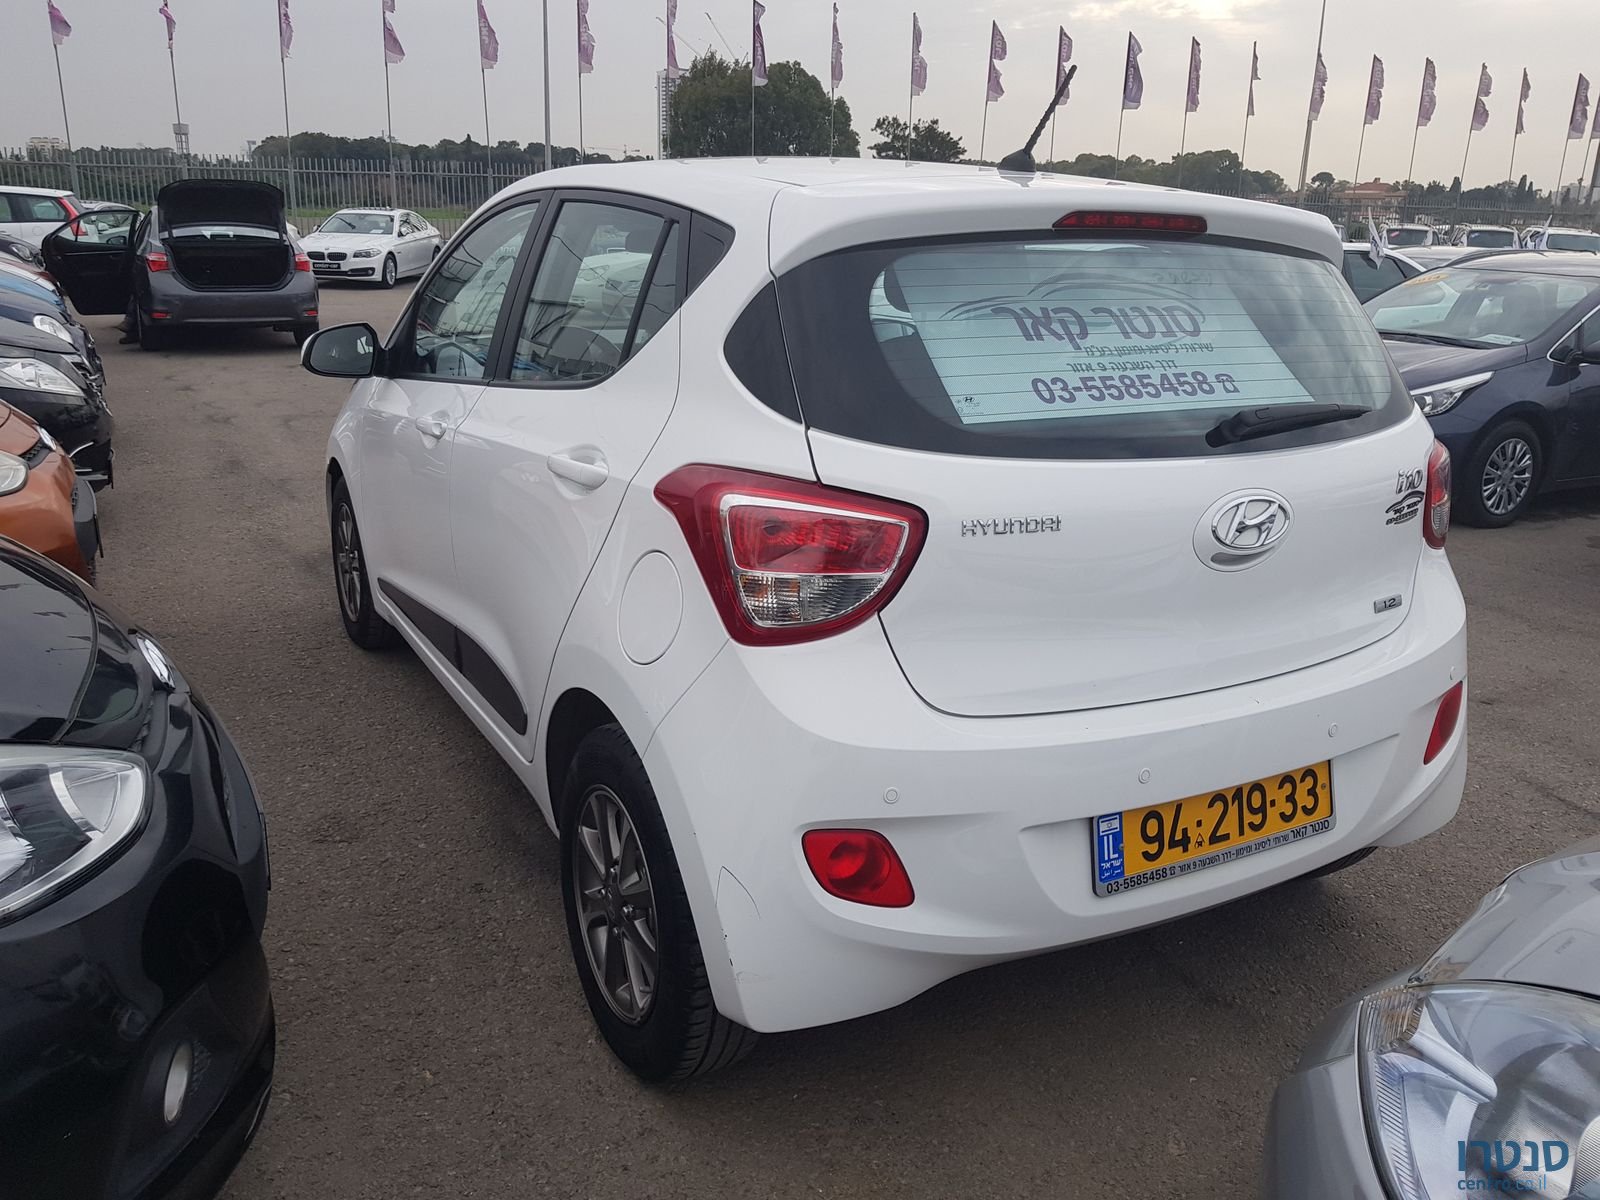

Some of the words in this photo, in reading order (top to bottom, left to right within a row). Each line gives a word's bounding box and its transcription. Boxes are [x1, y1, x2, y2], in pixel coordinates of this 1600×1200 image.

[990, 306, 1088, 351] קאר
[1090, 305, 1201, 340] סנטר
[1066, 363, 1095, 372] אזור
[1155, 360, 1178, 371] דרך
[1031, 370, 1216, 404] 03-5585458
[961, 514, 1063, 537] HYUNDAI
[1290, 826, 1308, 842] קאר
[1309, 819, 1330, 833] סנטר
[1104, 834, 1119, 861] IL
[1100, 858, 1123, 870] ישראל
[1178, 863, 1192, 873] אזור
[1106, 867, 1168, 895] 03-5585458
